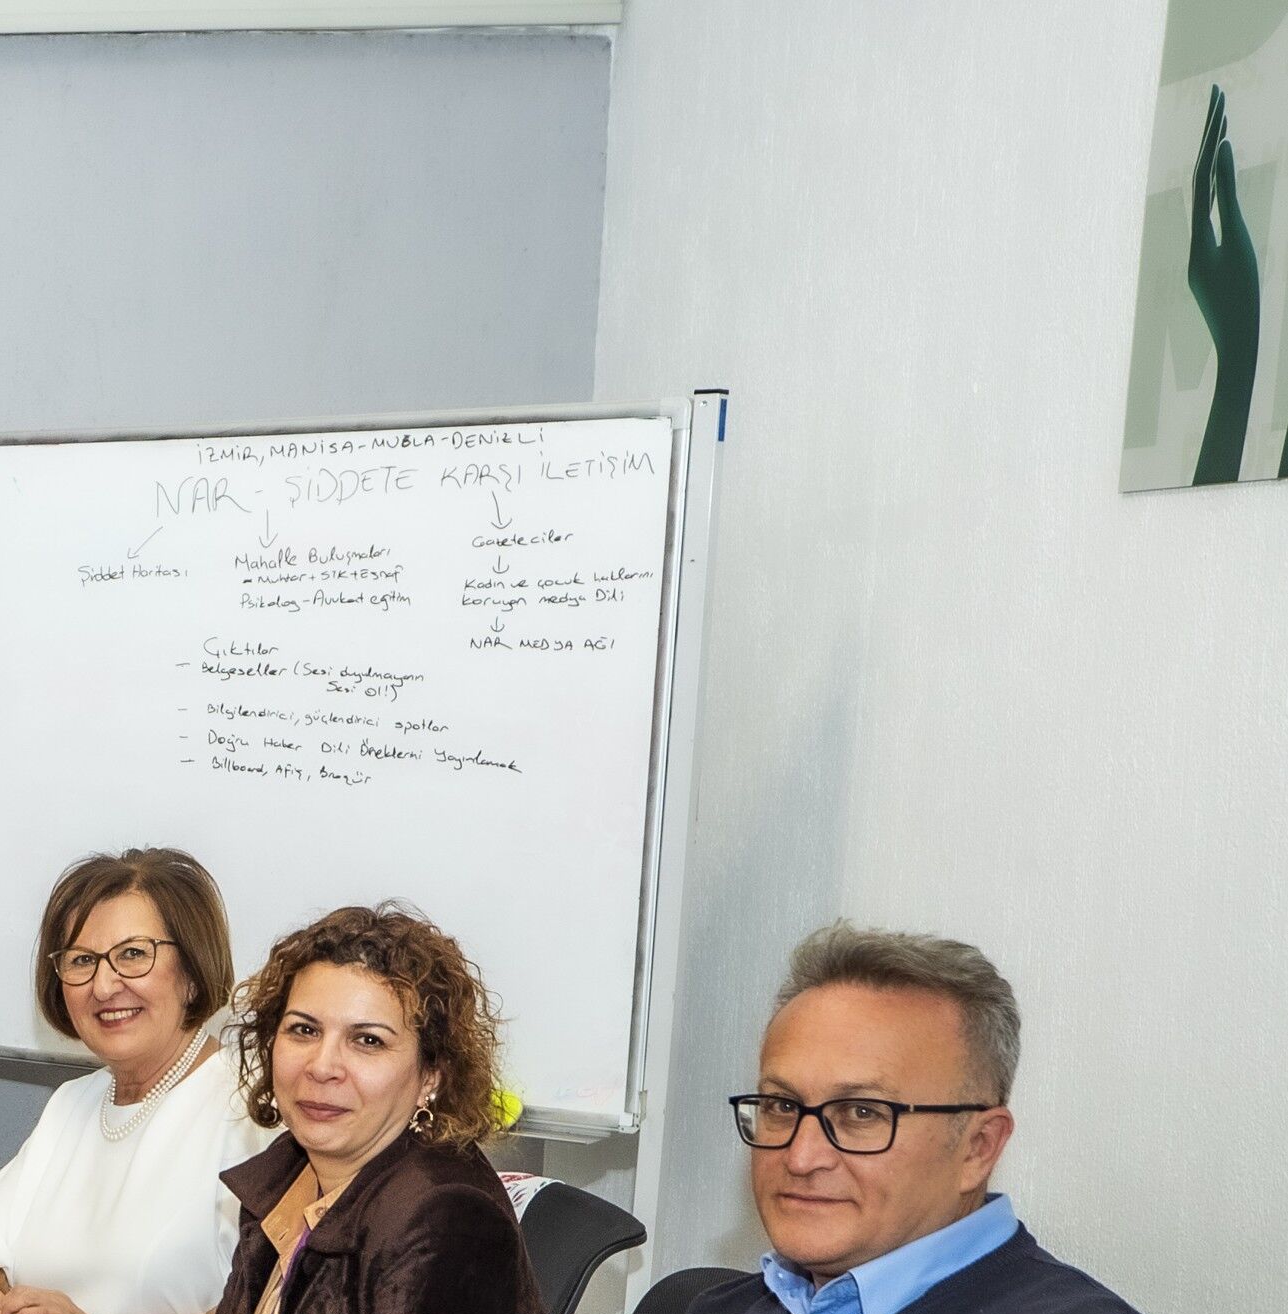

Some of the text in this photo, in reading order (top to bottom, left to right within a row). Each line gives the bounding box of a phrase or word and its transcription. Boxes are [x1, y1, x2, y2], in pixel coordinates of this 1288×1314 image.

[156, 476, 252, 518] NAR
[285, 465, 420, 509] ŞİDDETE
[440, 462, 522, 492] KARŞI
